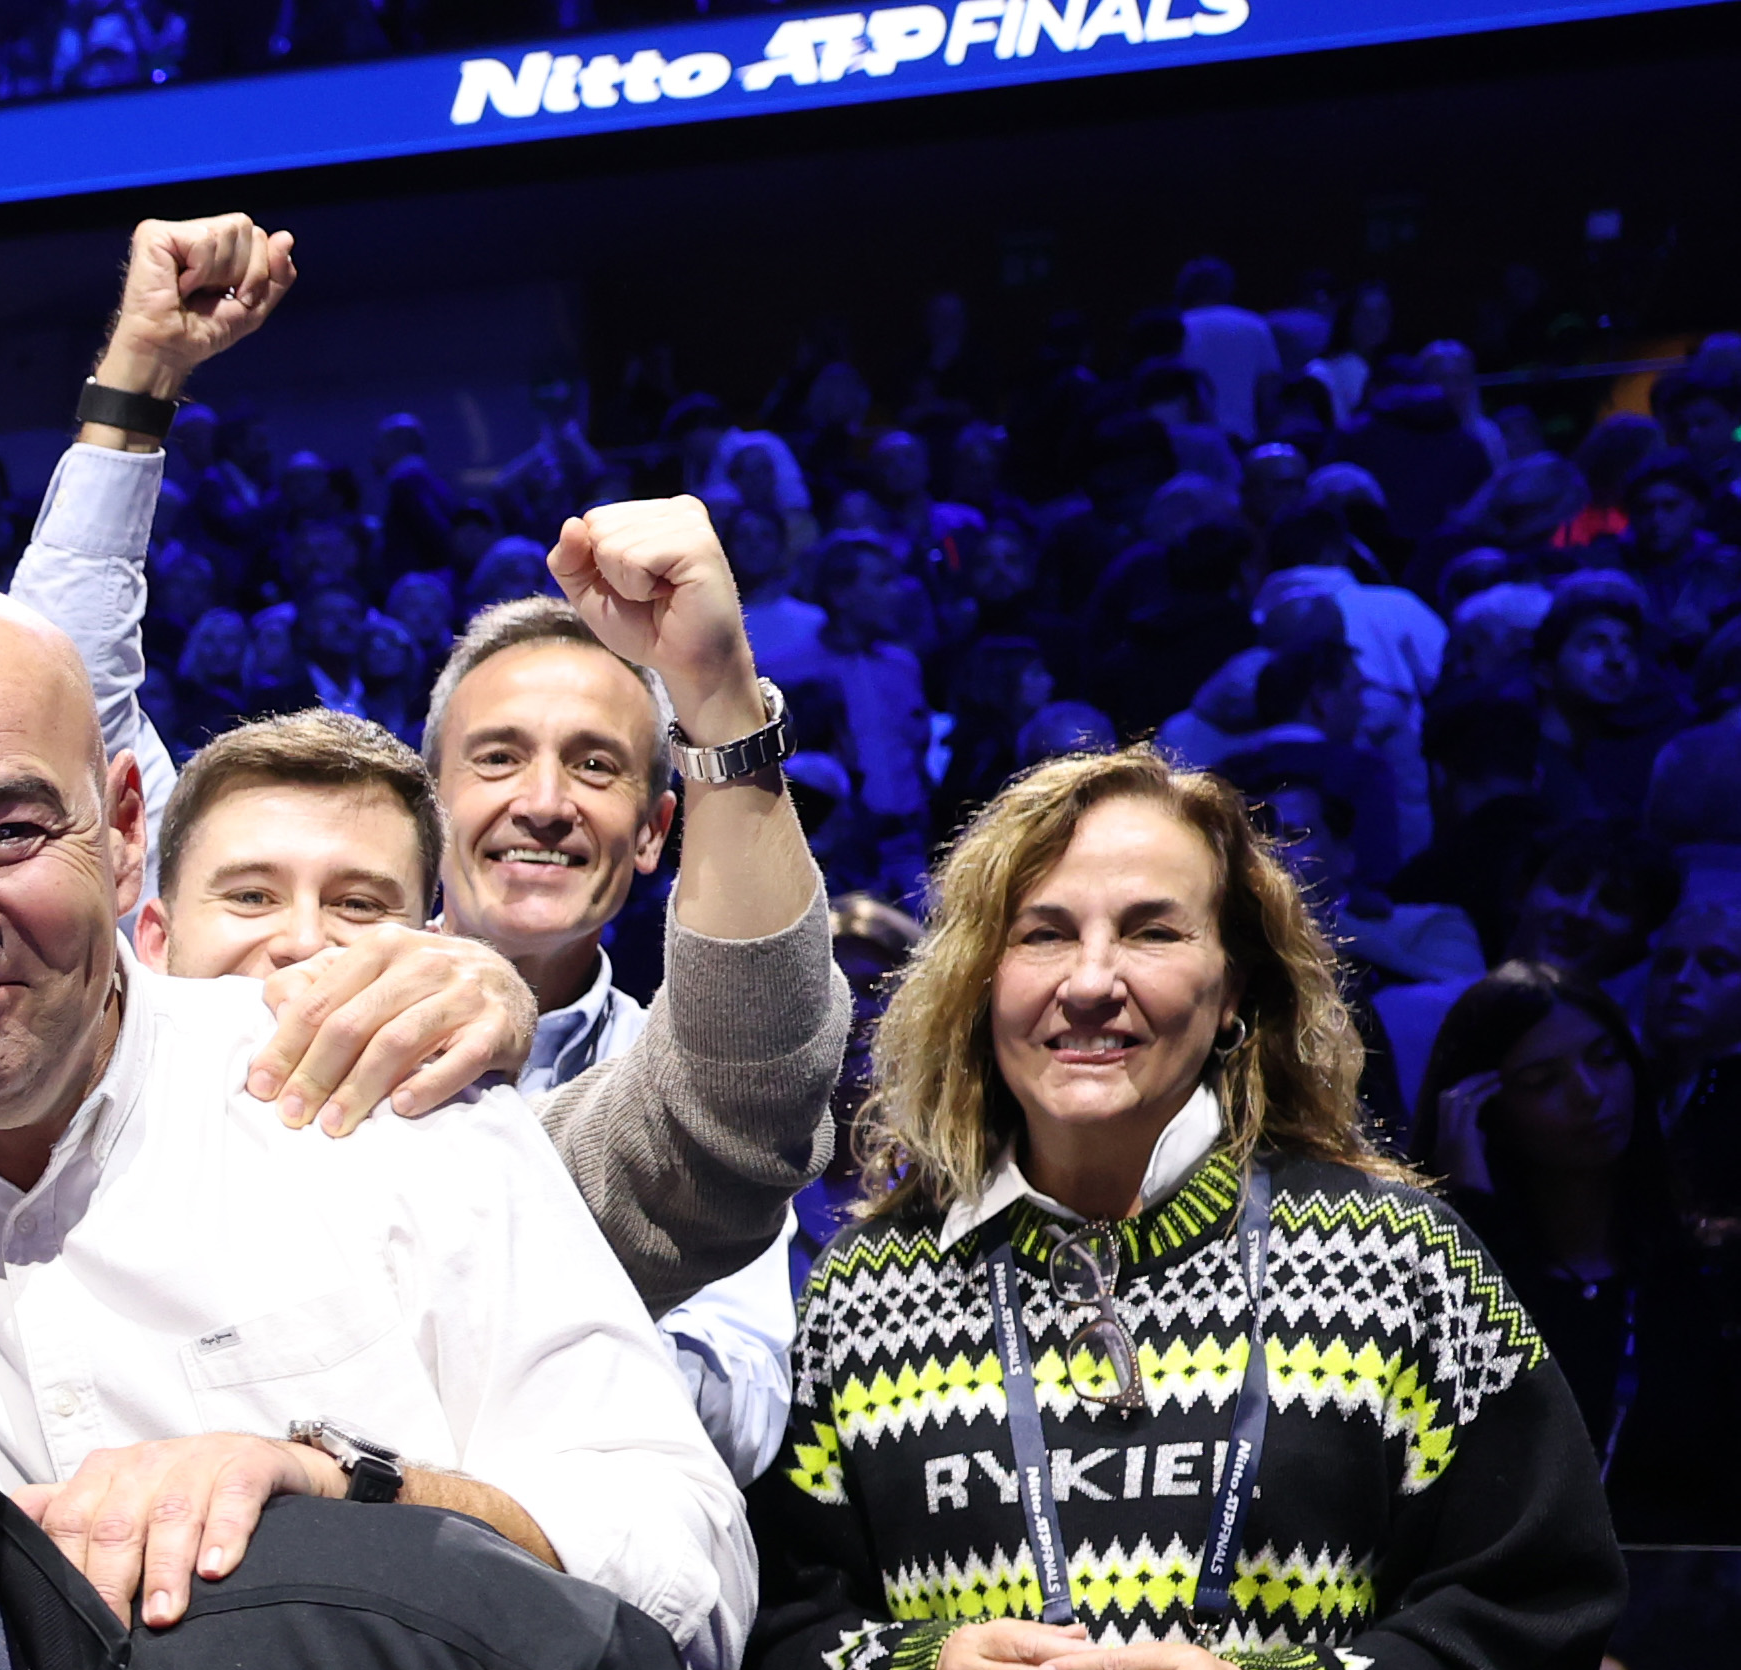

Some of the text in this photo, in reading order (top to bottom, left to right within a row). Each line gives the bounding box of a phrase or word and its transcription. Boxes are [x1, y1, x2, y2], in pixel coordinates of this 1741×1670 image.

[450, 50, 731, 125] Nitto
[1026, 1466, 1042, 1514] Nitto
[1230, 1439, 1252, 1490] Nitto
